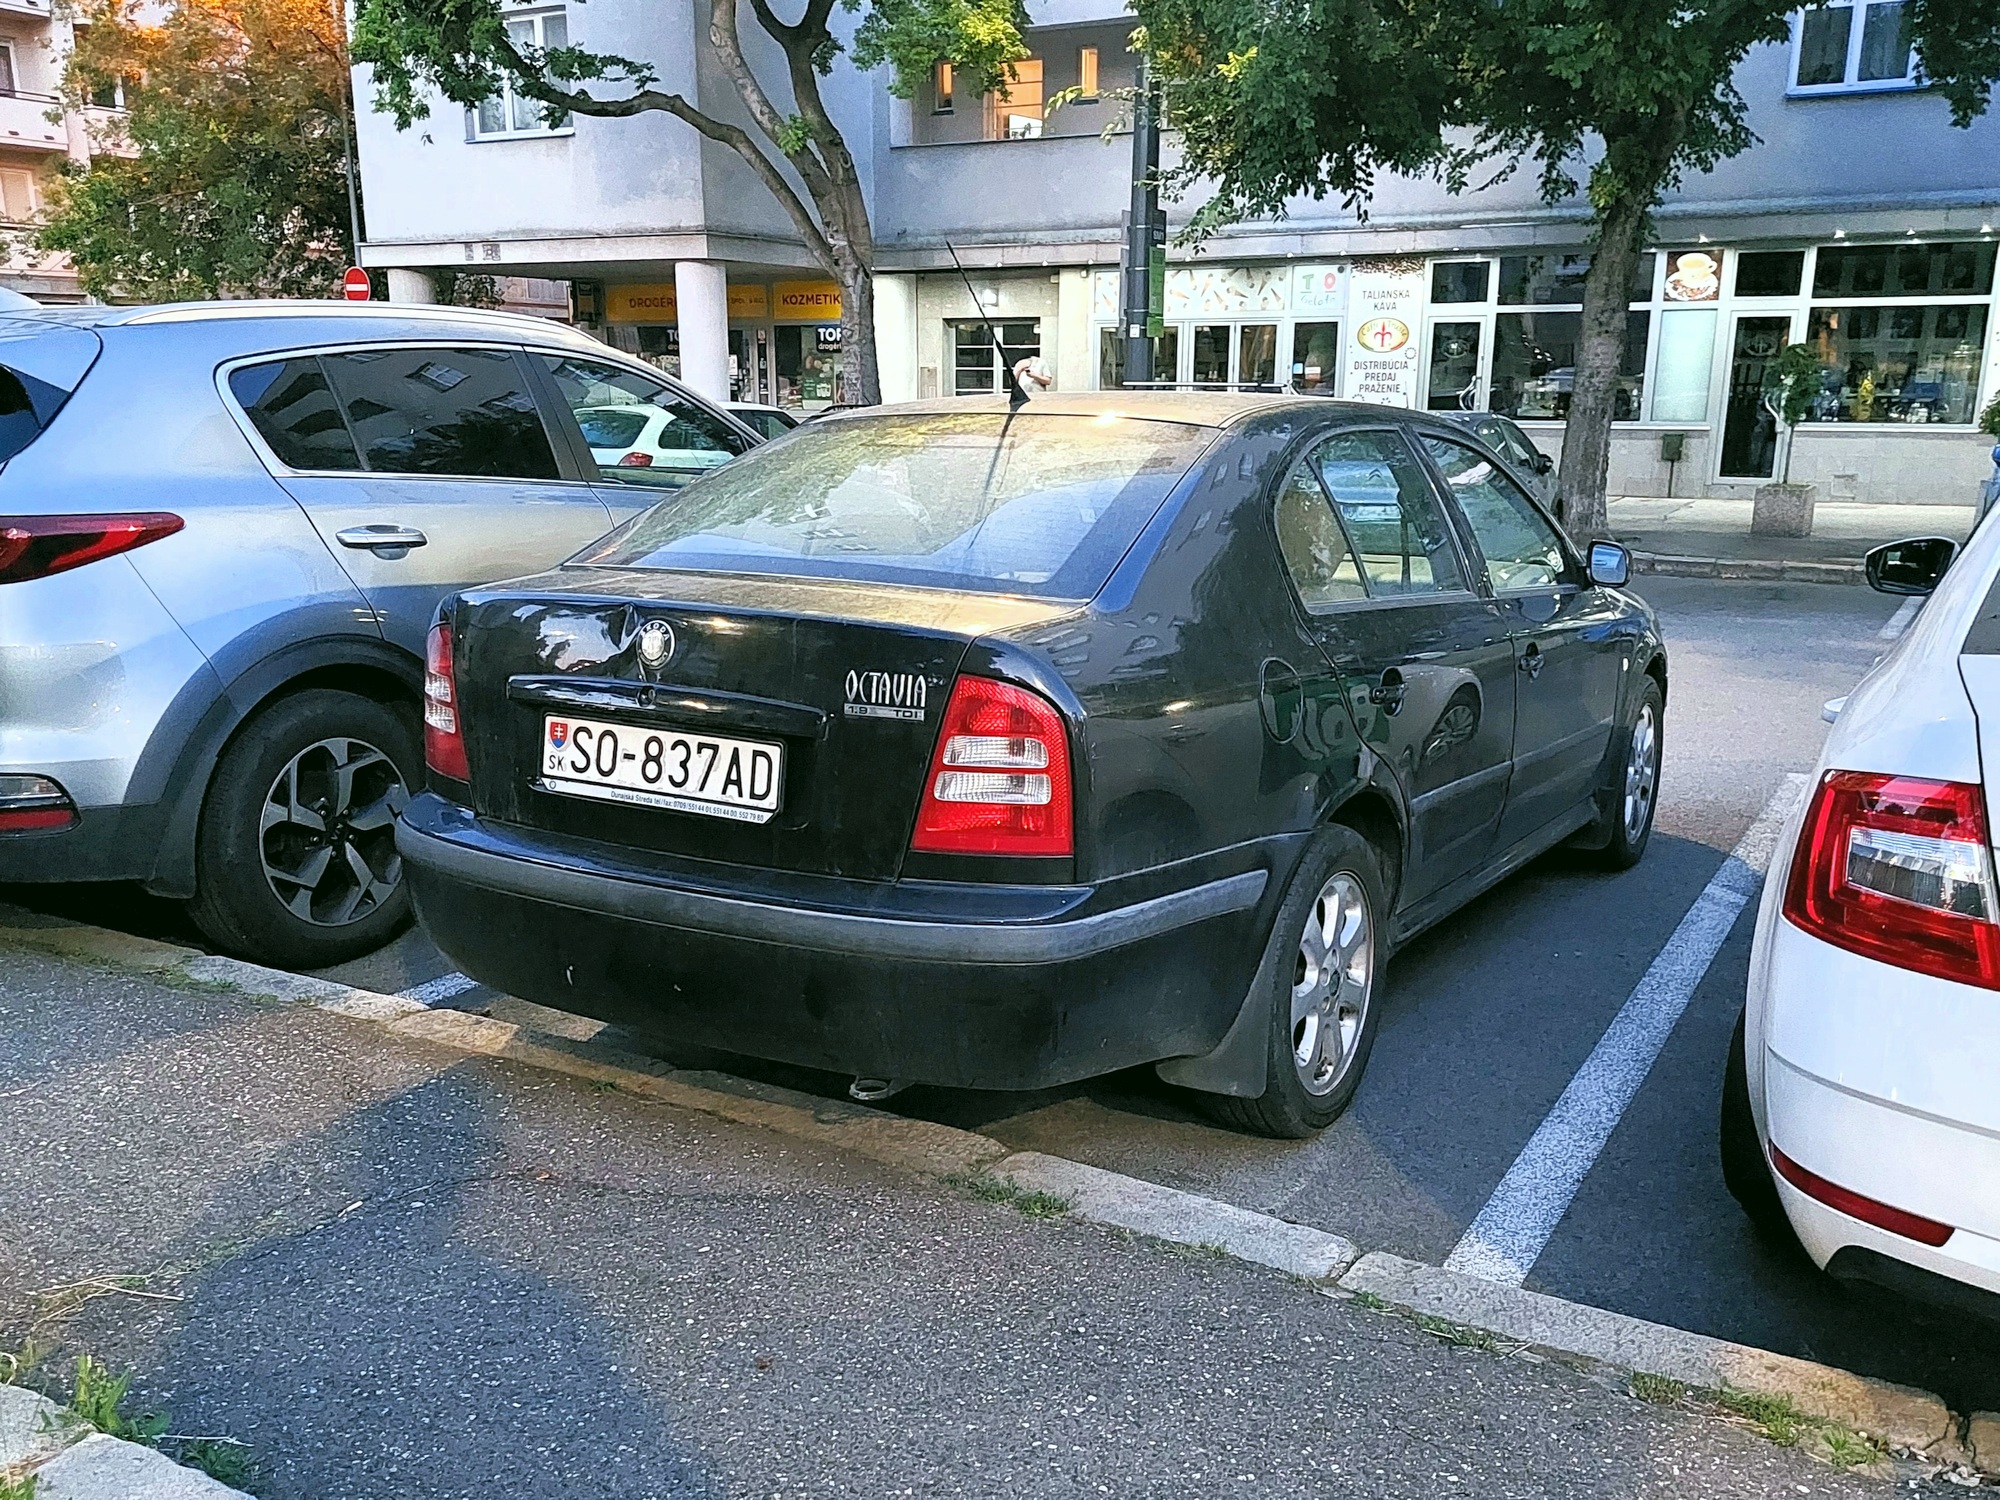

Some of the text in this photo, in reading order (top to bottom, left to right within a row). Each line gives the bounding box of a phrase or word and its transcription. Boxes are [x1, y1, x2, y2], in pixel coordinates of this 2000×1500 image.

[1362, 289, 1410, 300] TALIANSKA
[1354, 359, 1409, 370] DISTRIBÚCIA
[1365, 372, 1397, 382] PREDAJ
[1359, 381, 1401, 393] PRAŽENIE
[845, 669, 927, 708] OCTAVIA
[847, 705, 919, 720] 1.9 TDI
[548, 754, 565, 772] SK
[570, 726, 773, 801] SO-837AD
[610, 790, 635, 801] Dunajská
[635, 794, 653, 804] Streda
